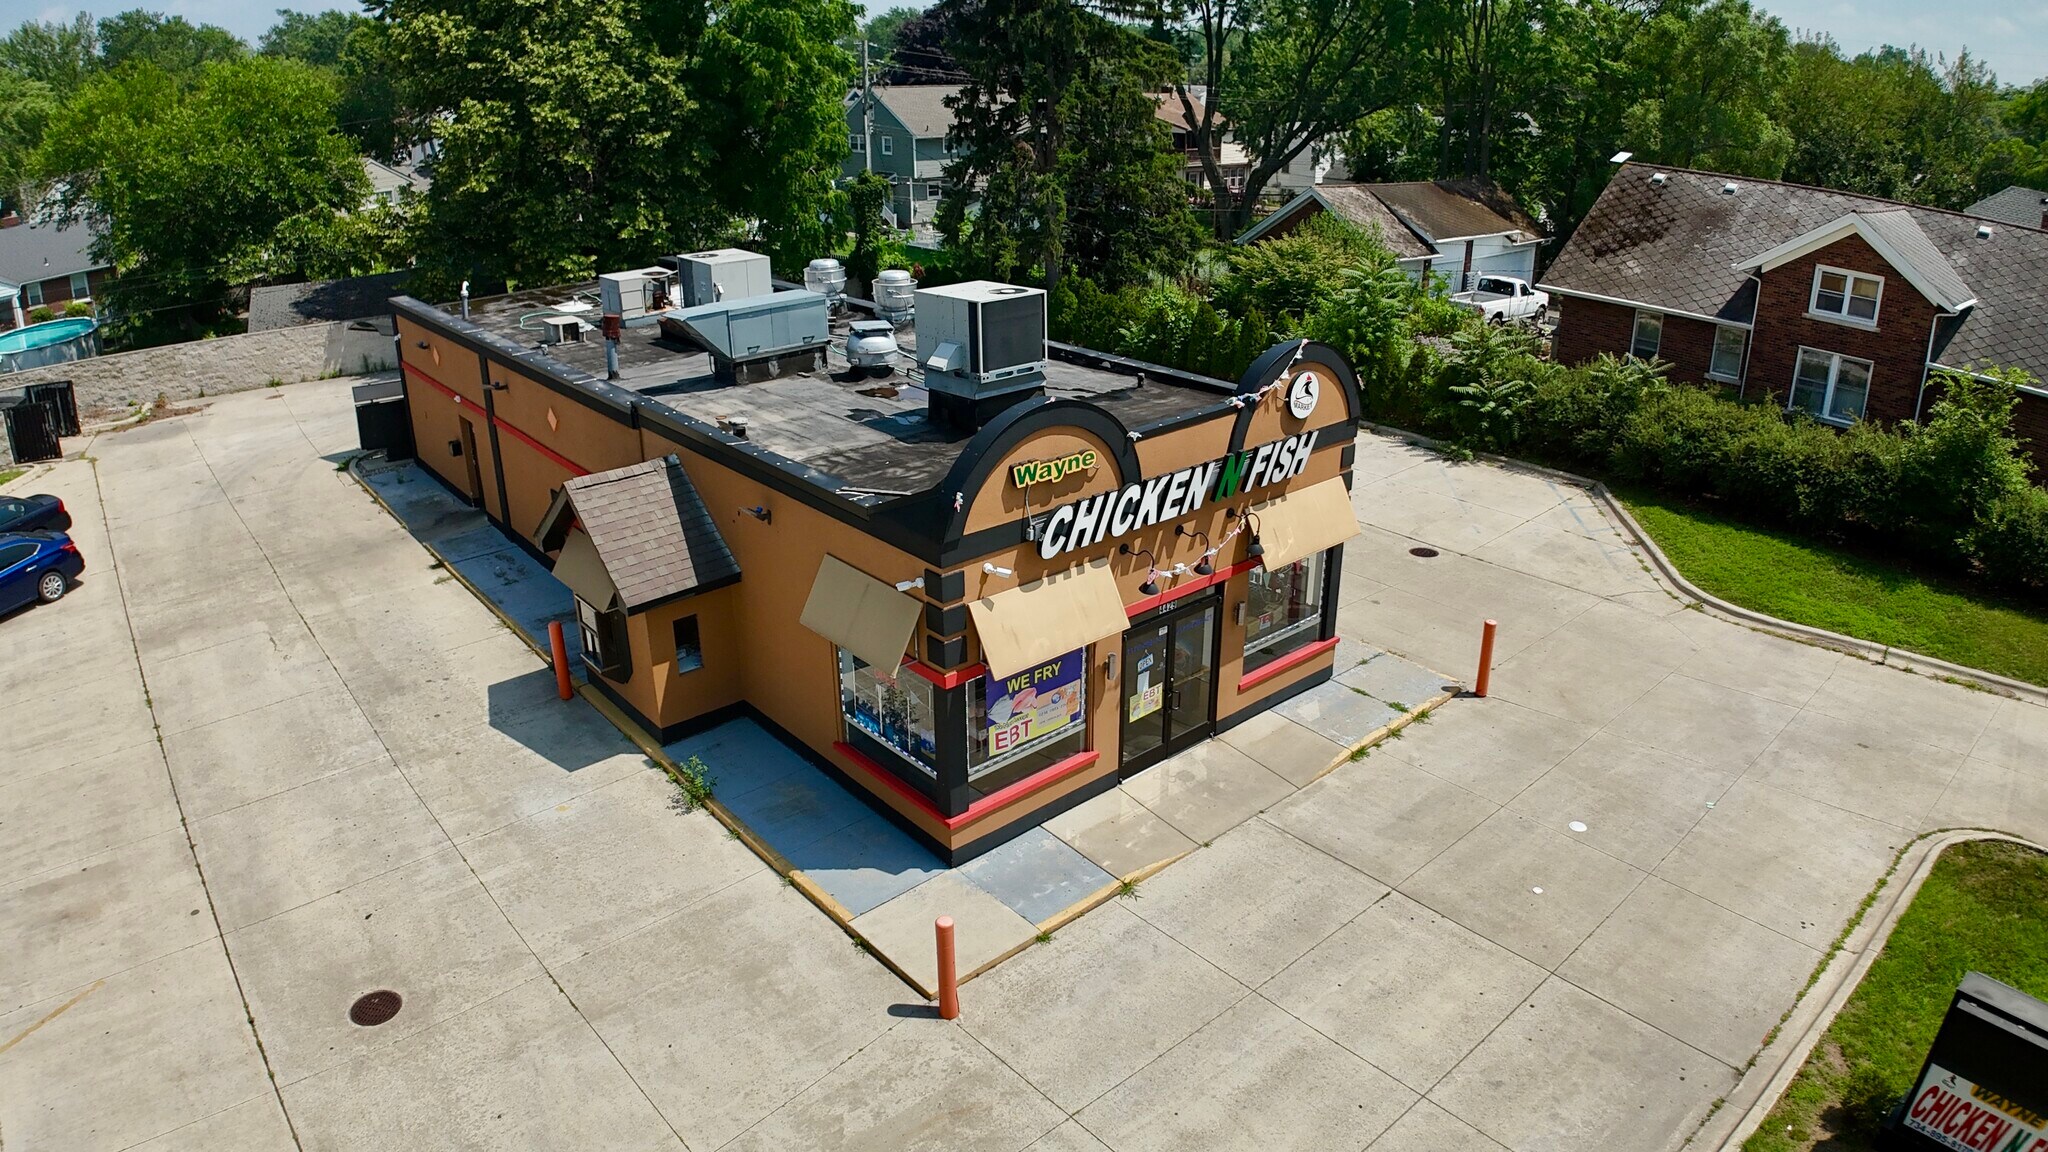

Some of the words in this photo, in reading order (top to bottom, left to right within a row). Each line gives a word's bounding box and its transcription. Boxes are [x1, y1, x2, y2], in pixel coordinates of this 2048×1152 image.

[1014, 450, 1097, 489] Wayne
[1040, 462, 1215, 560] CHICKEN
[1214, 451, 1247, 502] N
[1244, 430, 1319, 494] FISH
[1007, 674, 1031, 694] WE
[1033, 661, 1062, 684] FRY
[1138, 657, 1152, 670] OPEN
[1143, 685, 1161, 701] EBT
[994, 719, 1033, 750] EBT
[1910, 1085, 2013, 1152] CHICKEN
